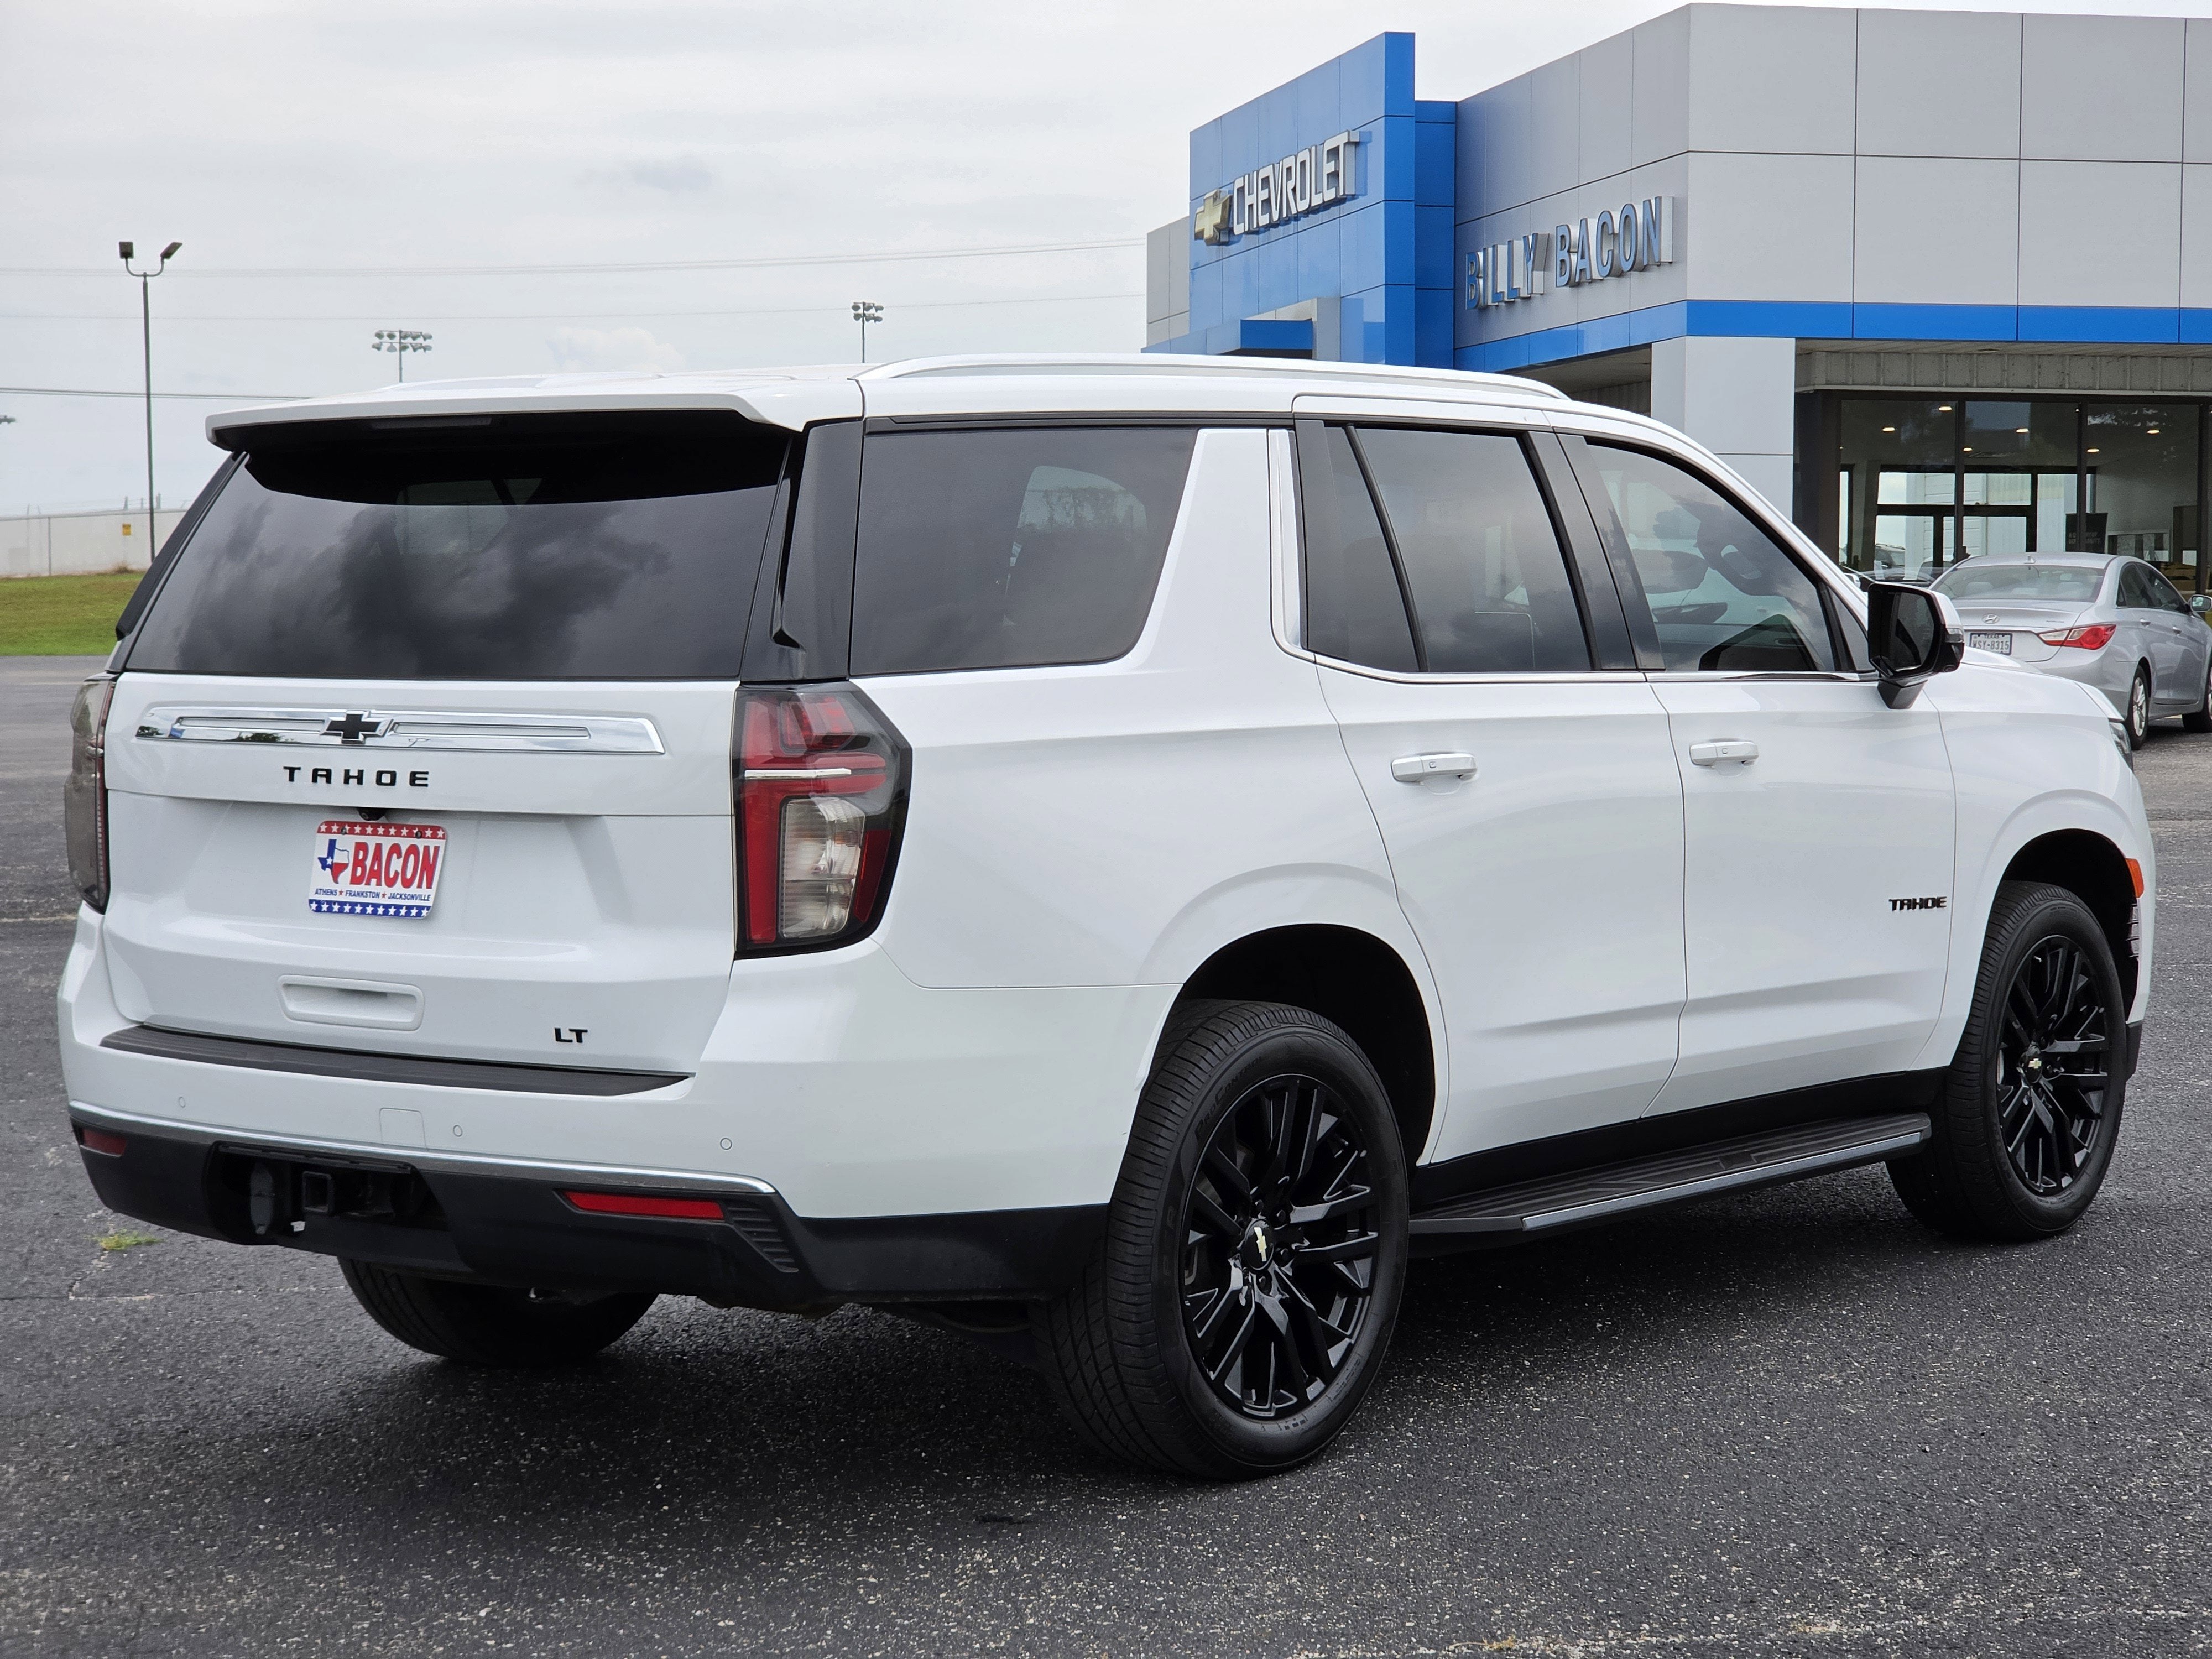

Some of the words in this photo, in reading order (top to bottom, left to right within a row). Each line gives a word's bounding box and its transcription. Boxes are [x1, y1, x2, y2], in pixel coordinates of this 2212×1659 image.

[1233, 129, 1354, 236] CHEVROLET
[1465, 232, 1544, 310] BILLY
[1556, 196, 1667, 288] BACON
[283, 766, 429, 787] TAHOE
[349, 841, 441, 889] BACON
[315, 888, 338, 896] ATHENS
[345, 890, 380, 899] FRANKSTON
[388, 893, 431, 901] JACKSONVILLE
[1888, 896, 1947, 911] TAHOE
[554, 1027, 588, 1044] LT
